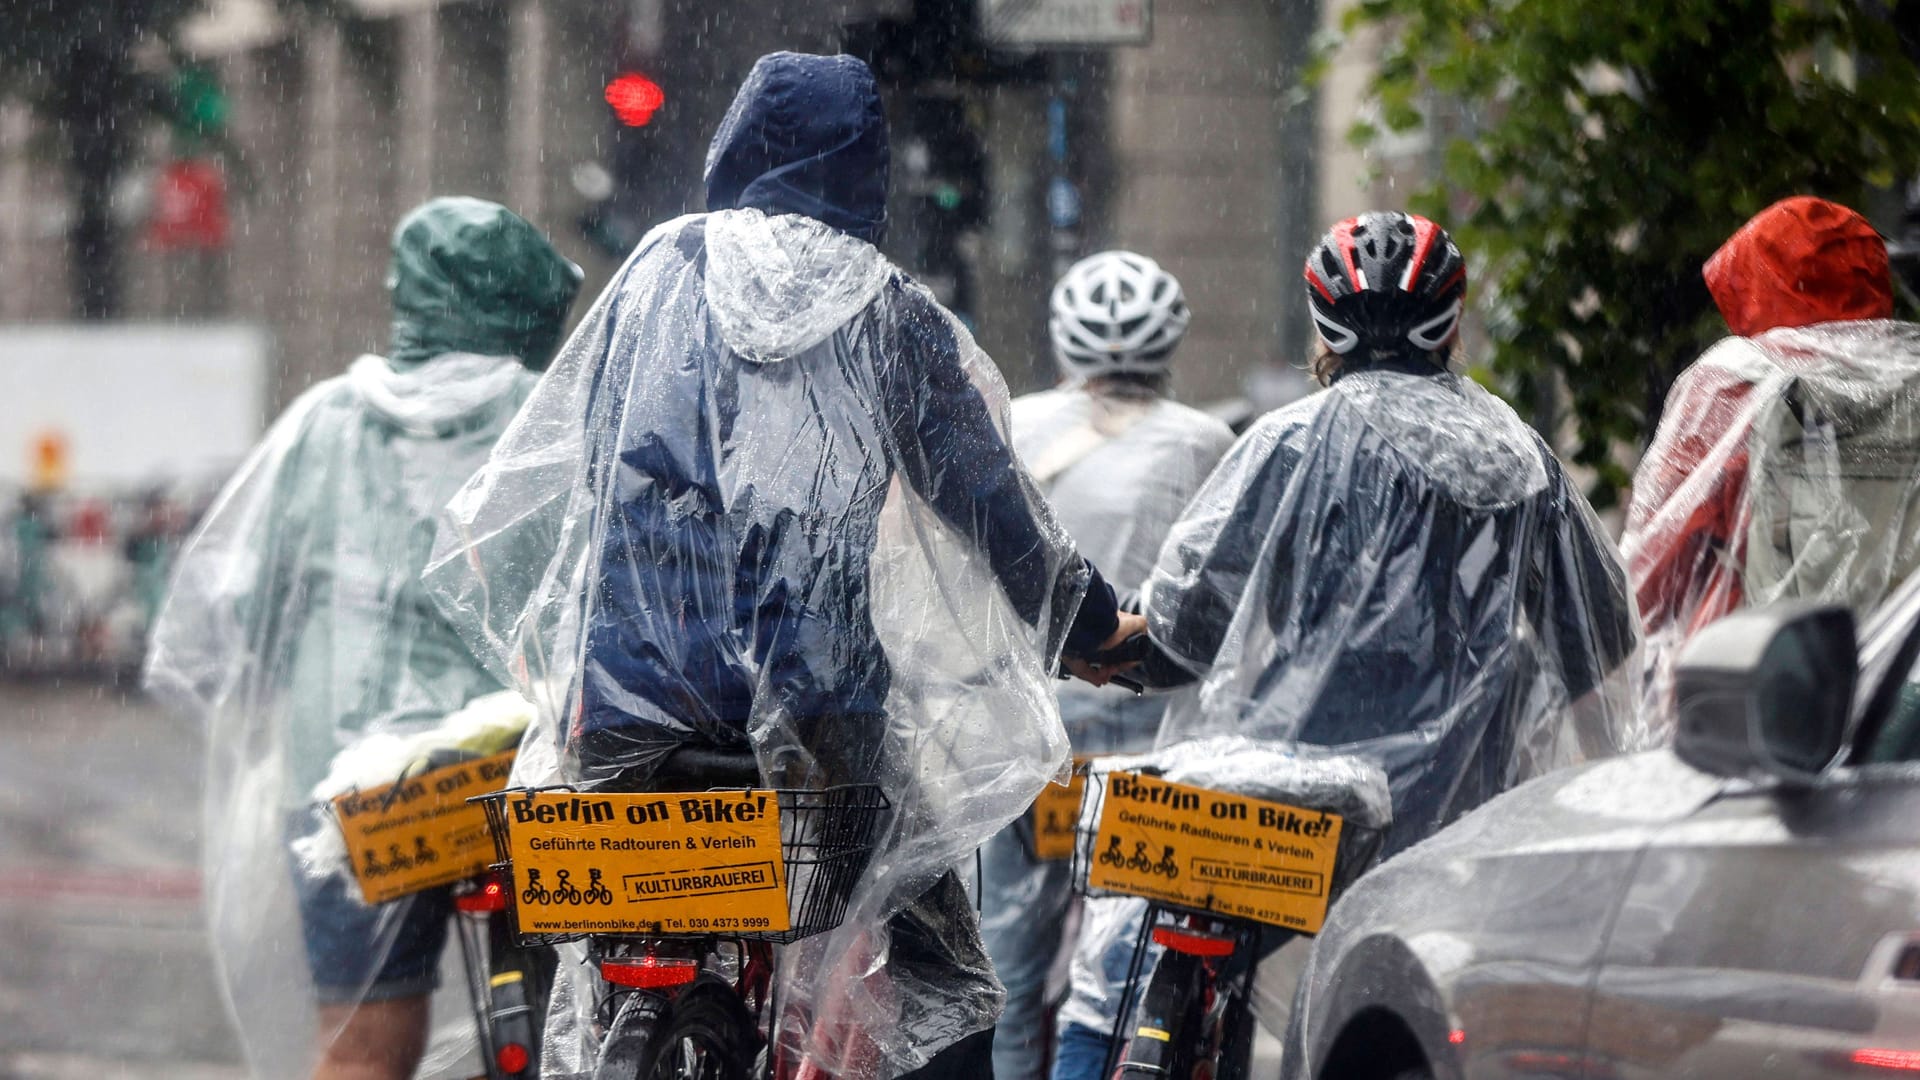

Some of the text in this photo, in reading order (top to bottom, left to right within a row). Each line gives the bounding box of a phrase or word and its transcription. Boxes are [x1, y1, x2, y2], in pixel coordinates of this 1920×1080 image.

[512, 796, 767, 825] Berlin on Bike!
[1112, 777, 1333, 838] Berlin on Bike!
[530, 836, 756, 851] Geführte Radtouren & Verleih
[1119, 810, 1315, 860] Geführte Radtouren & Verleih
[635, 869, 765, 895] KULTURBRAUEREI
[1200, 863, 1314, 889] KULTURBRAUEREI
[664, 918, 686, 929] Tel.
[689, 918, 709, 929] 030
[712, 917, 739, 929] 4373
[742, 917, 770, 928] 9999
